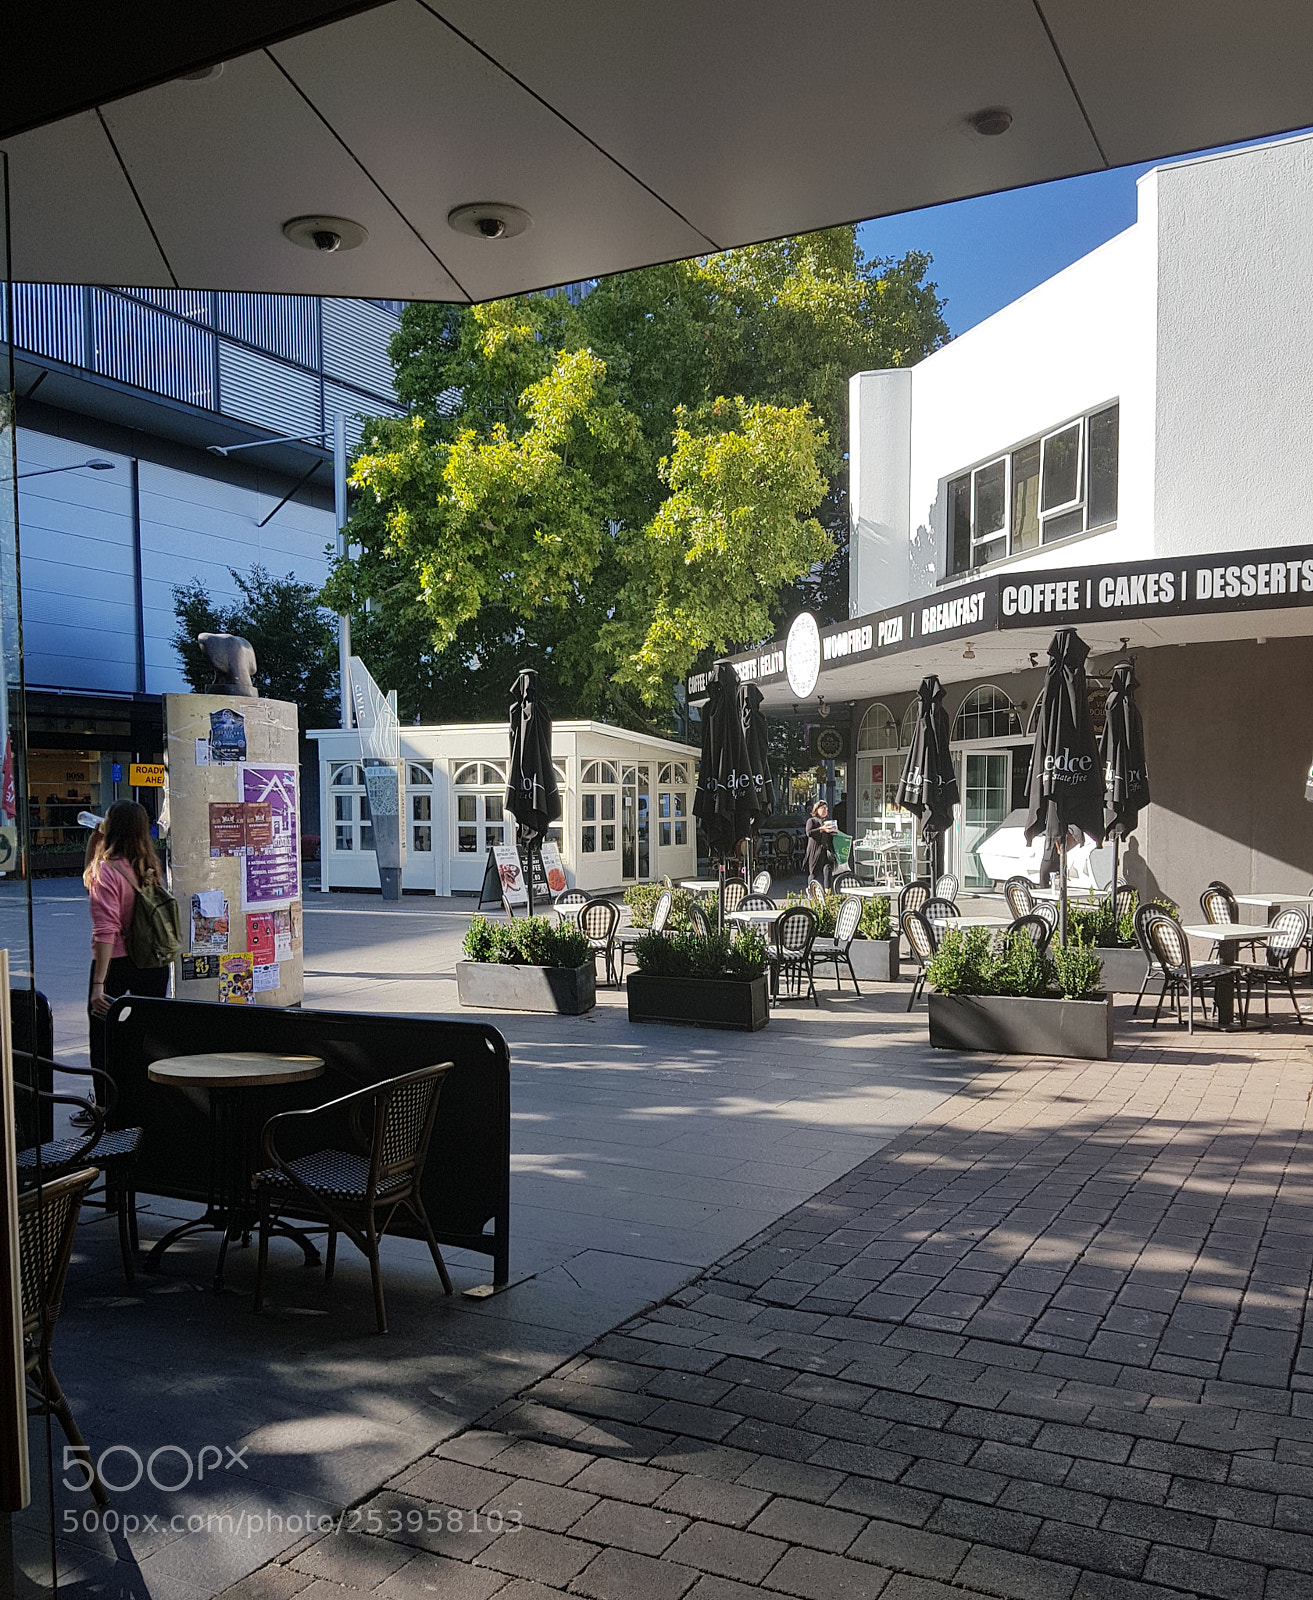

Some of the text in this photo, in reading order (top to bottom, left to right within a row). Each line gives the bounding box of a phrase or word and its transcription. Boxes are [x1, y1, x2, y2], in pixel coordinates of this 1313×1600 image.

[1002, 560, 1313, 616] COFFEE CAKES DESSERTS
[878, 616, 903, 647] PIZZA
[921, 591, 986, 635] BREAKFAST
[760, 650, 784, 677] GELATO
[355, 684, 366, 719] CIVIC
